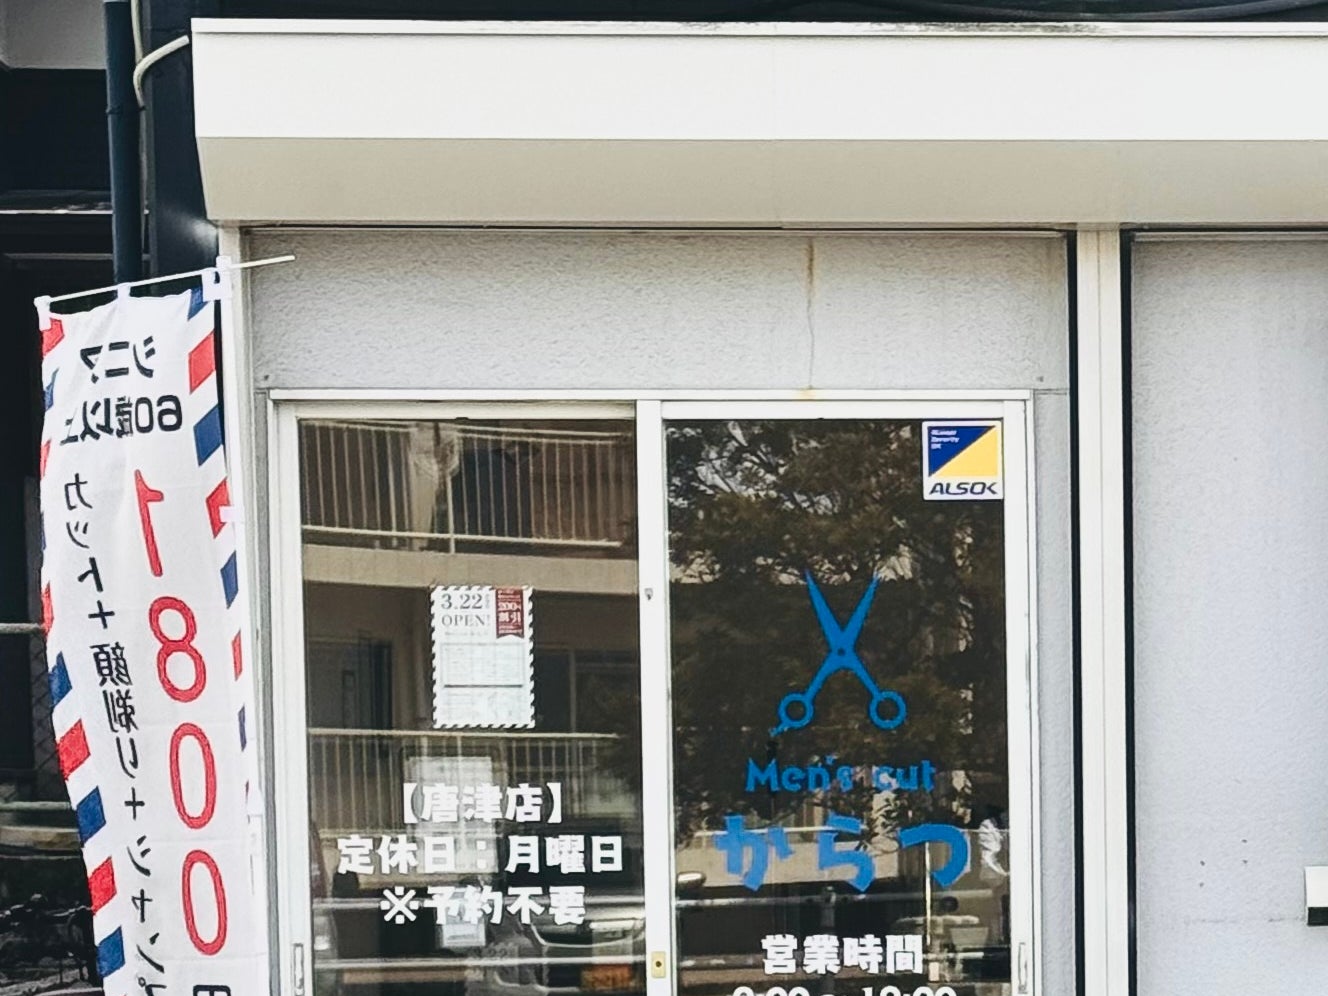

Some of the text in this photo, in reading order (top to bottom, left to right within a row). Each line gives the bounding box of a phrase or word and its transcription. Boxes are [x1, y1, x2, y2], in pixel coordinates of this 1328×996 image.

[929, 481, 998, 496] ALSOK
[441, 593, 483, 610] 3.22
[745, 754, 937, 792] Men's cut
[714, 811, 971, 892] からつ
[761, 933, 924, 975] 営業時間
